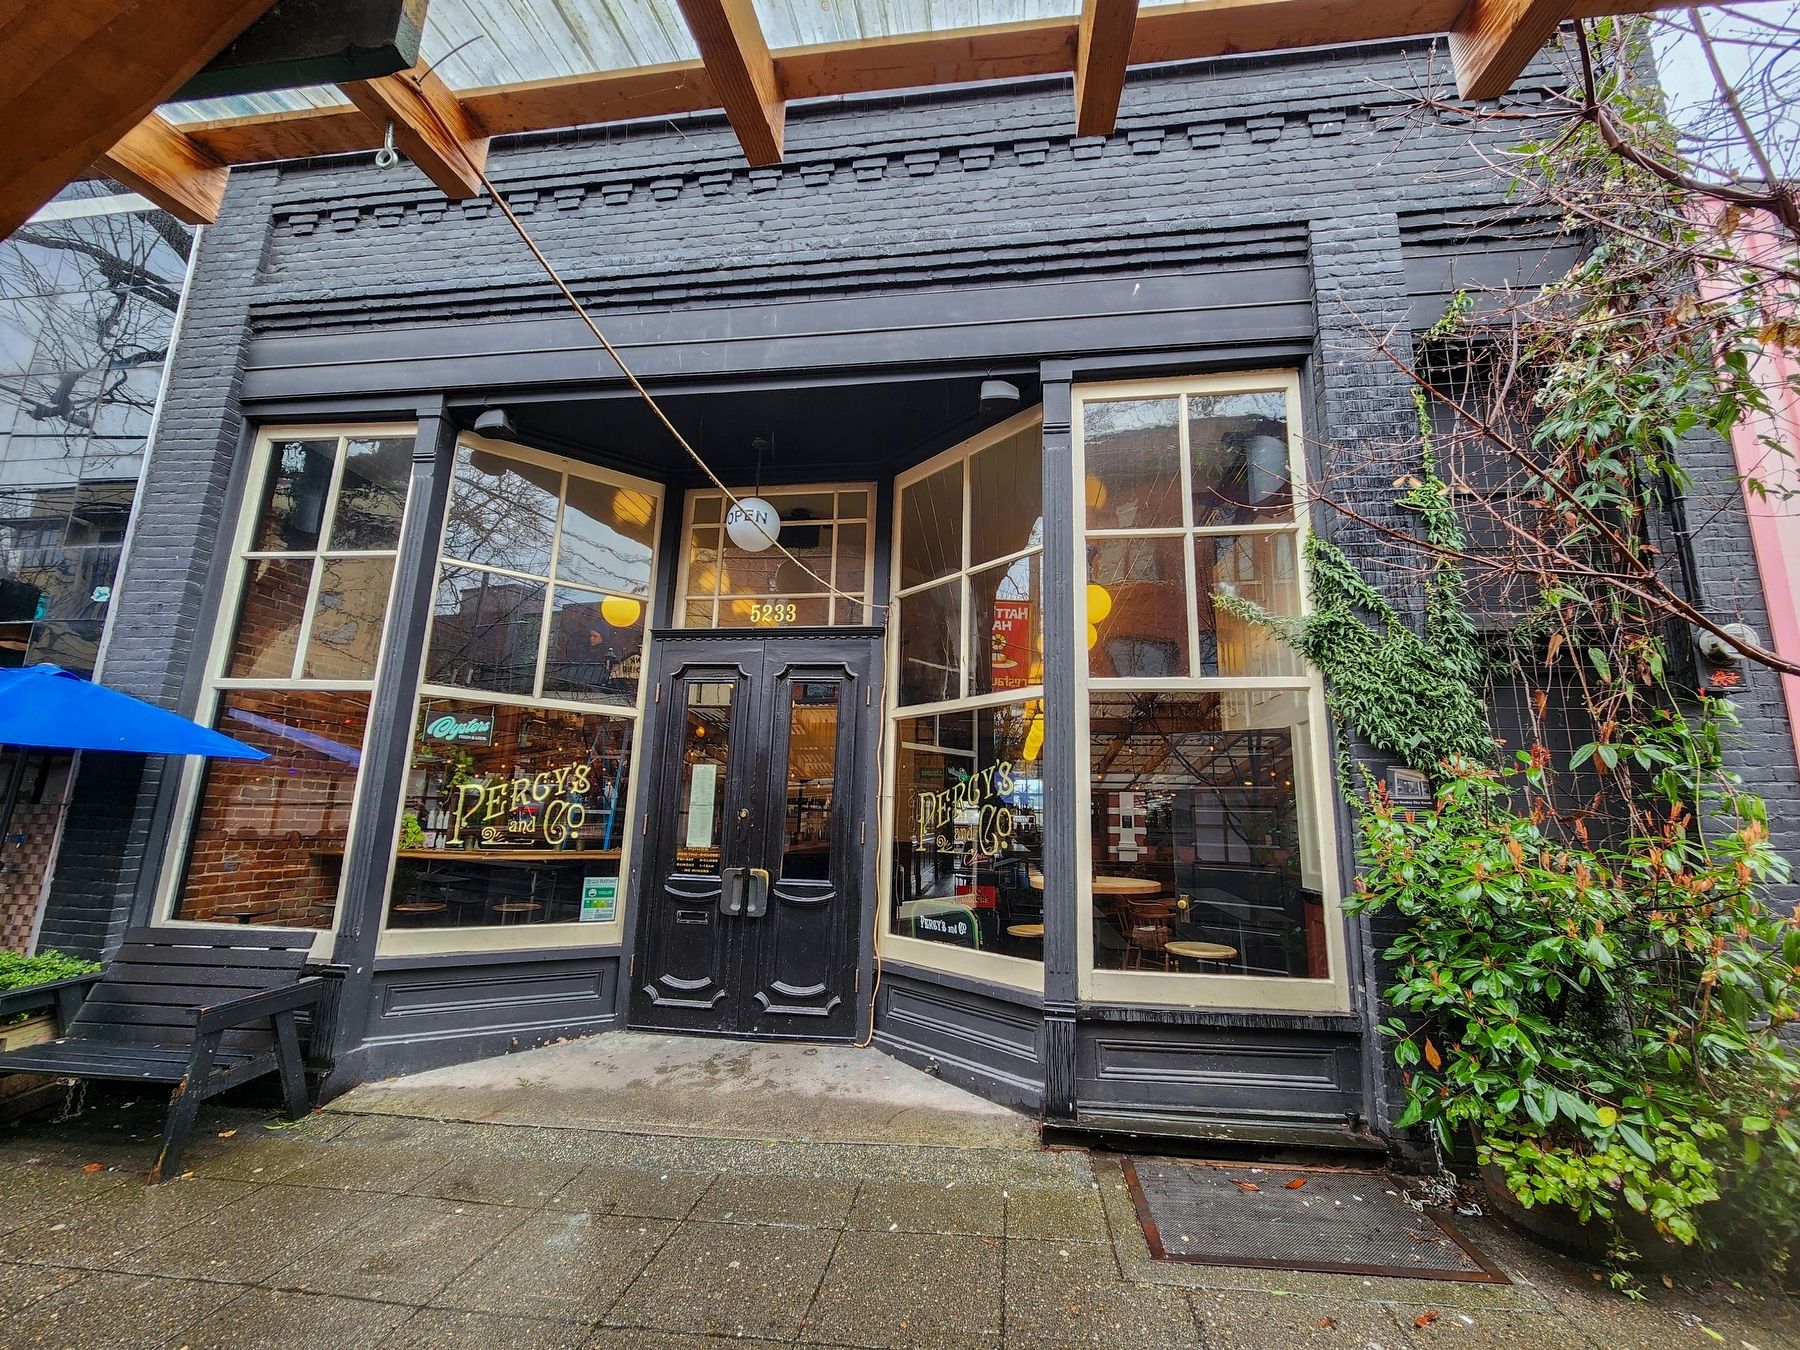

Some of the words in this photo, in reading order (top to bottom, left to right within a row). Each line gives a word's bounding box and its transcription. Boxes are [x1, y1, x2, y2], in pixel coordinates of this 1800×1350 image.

[727, 508, 768, 526] OPEN
[750, 603, 797, 623] 5233
[426, 716, 491, 741] Oysters
[446, 762, 592, 845] PERCY'S
[916, 758, 1014, 852] PERCY'S
[508, 816, 535, 833] and
[954, 824, 973, 842] and
[920, 915, 947, 933] PERCY'S
[947, 924, 957, 934] and
